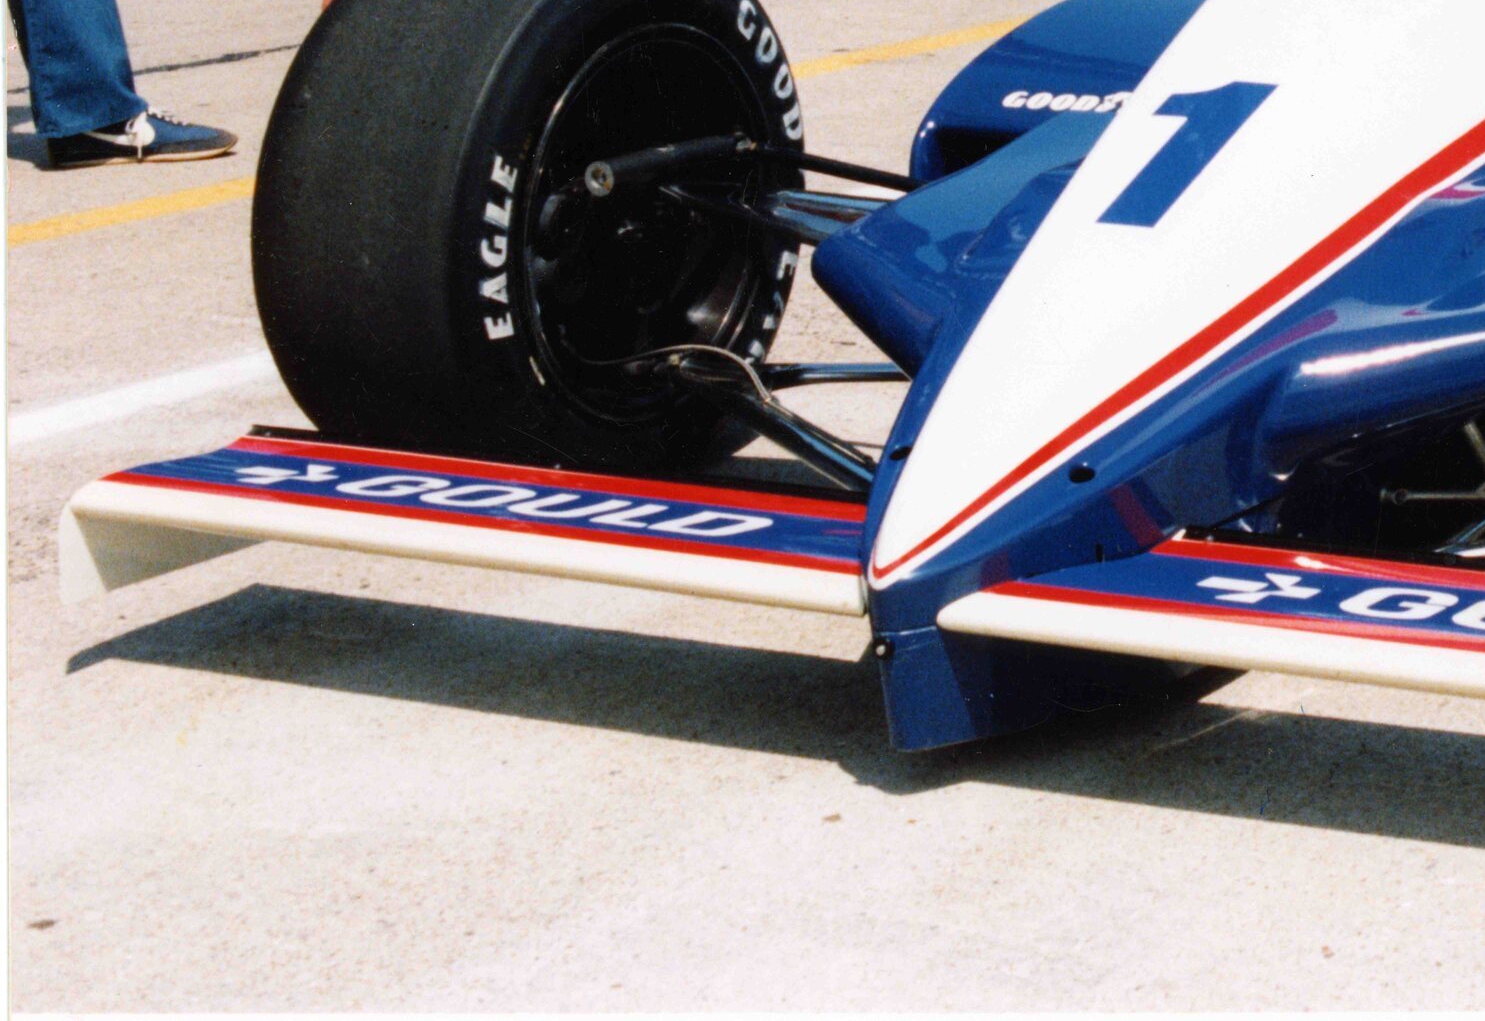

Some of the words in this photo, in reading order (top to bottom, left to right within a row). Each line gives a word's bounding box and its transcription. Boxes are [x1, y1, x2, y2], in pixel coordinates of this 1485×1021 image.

[1095, 80, 1280, 229] 1
[479, 154, 518, 340] EAGLE
[335, 474, 775, 537] GOULD
